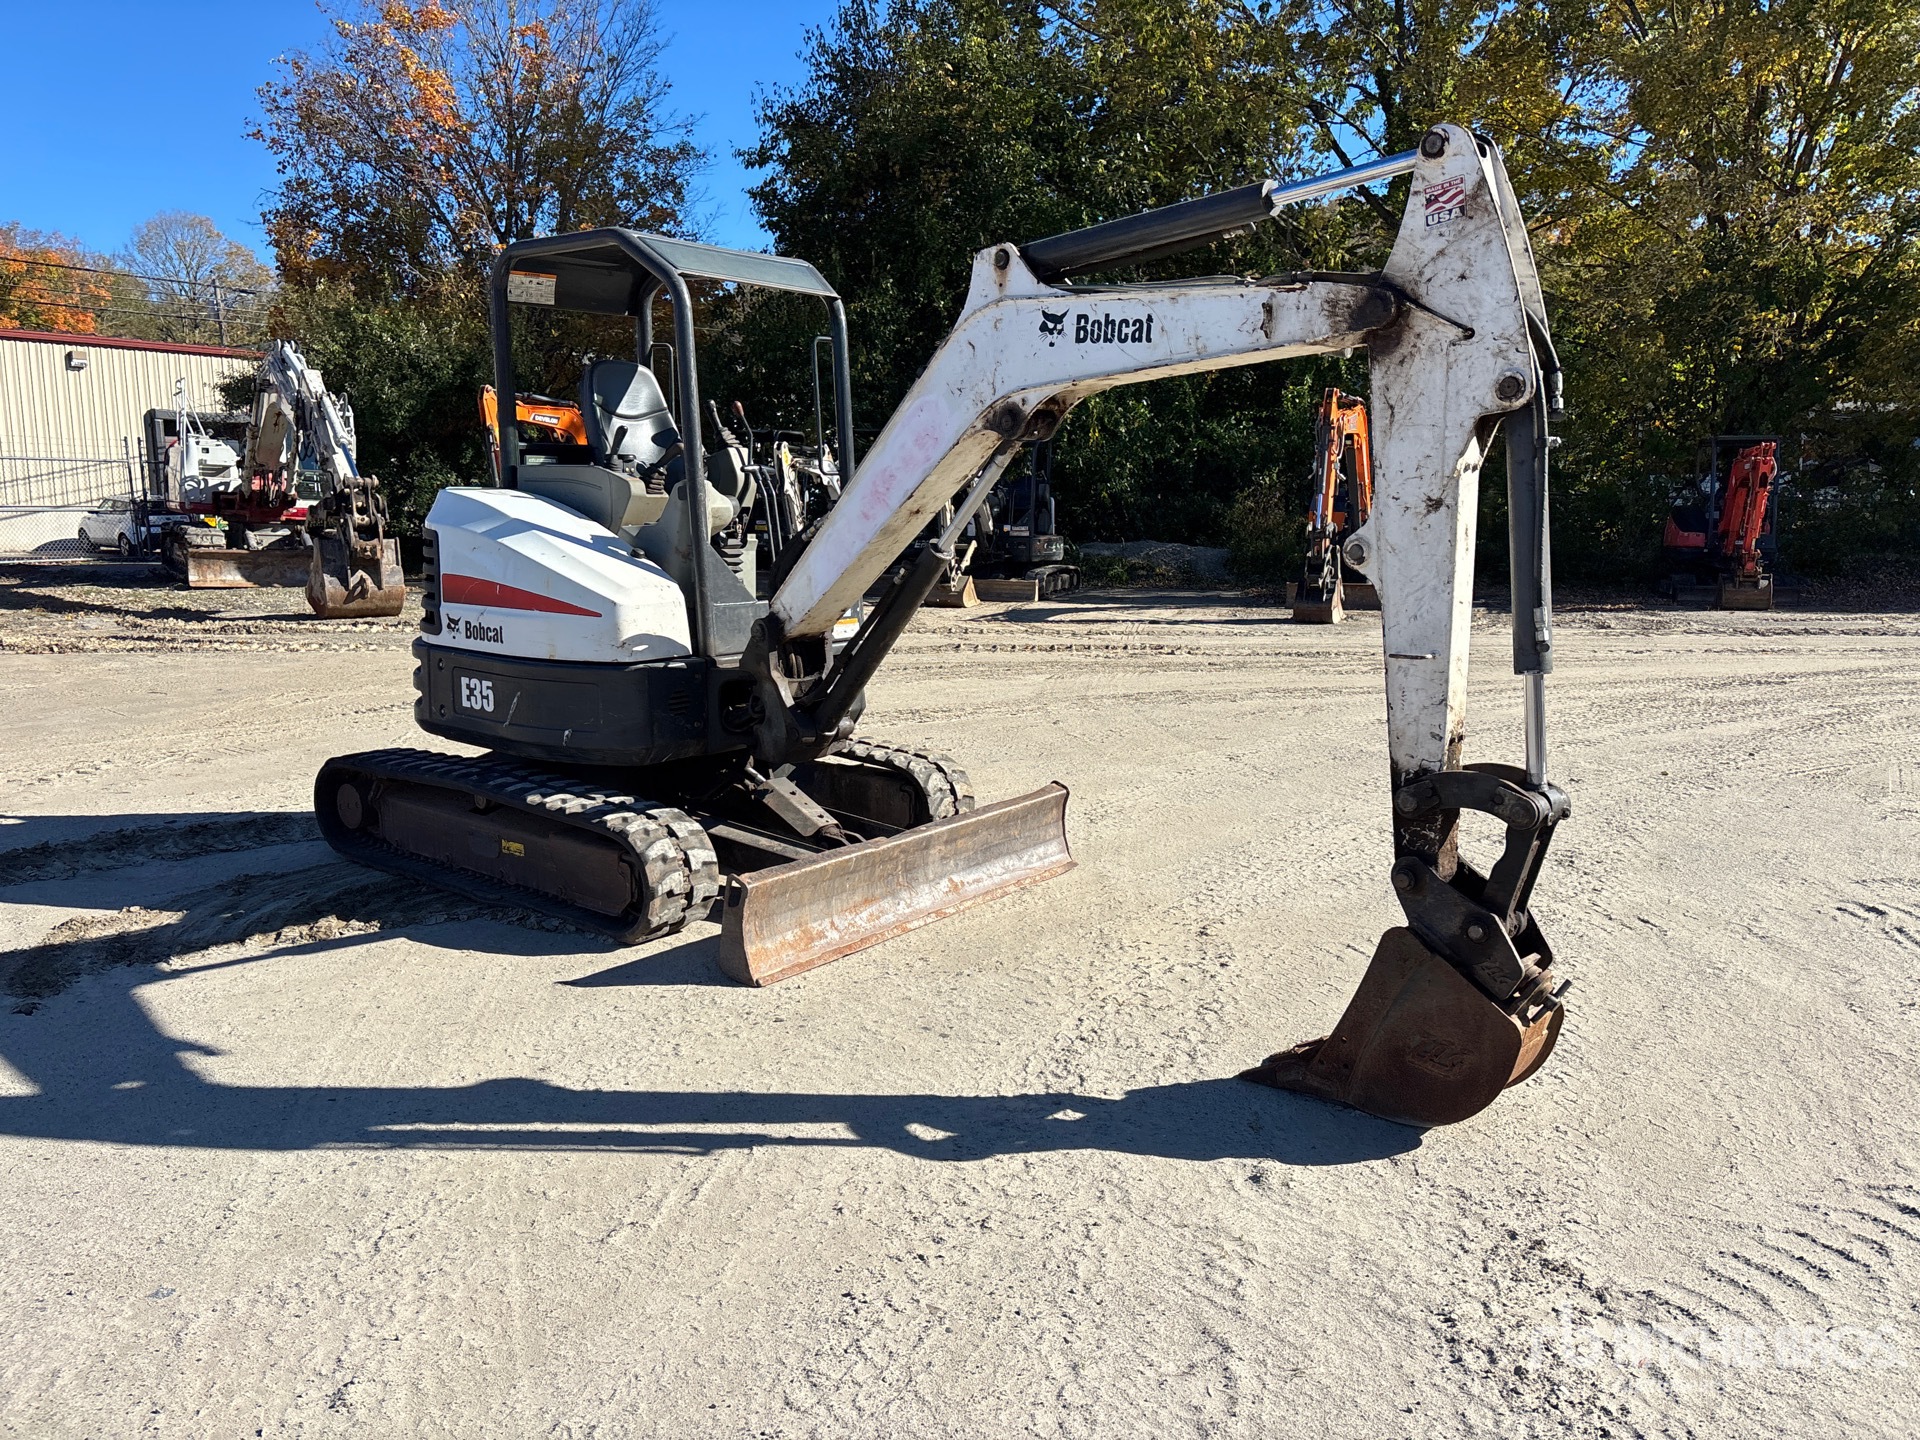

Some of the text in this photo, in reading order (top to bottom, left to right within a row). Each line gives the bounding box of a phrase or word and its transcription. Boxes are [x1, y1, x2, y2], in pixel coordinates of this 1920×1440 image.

[1426, 185, 1442, 193] MADE
[1427, 208, 1462, 225] USA
[1074, 312, 1154, 344] Bobcat
[465, 621, 504, 644] Bobcat
[460, 675, 495, 713] E35
